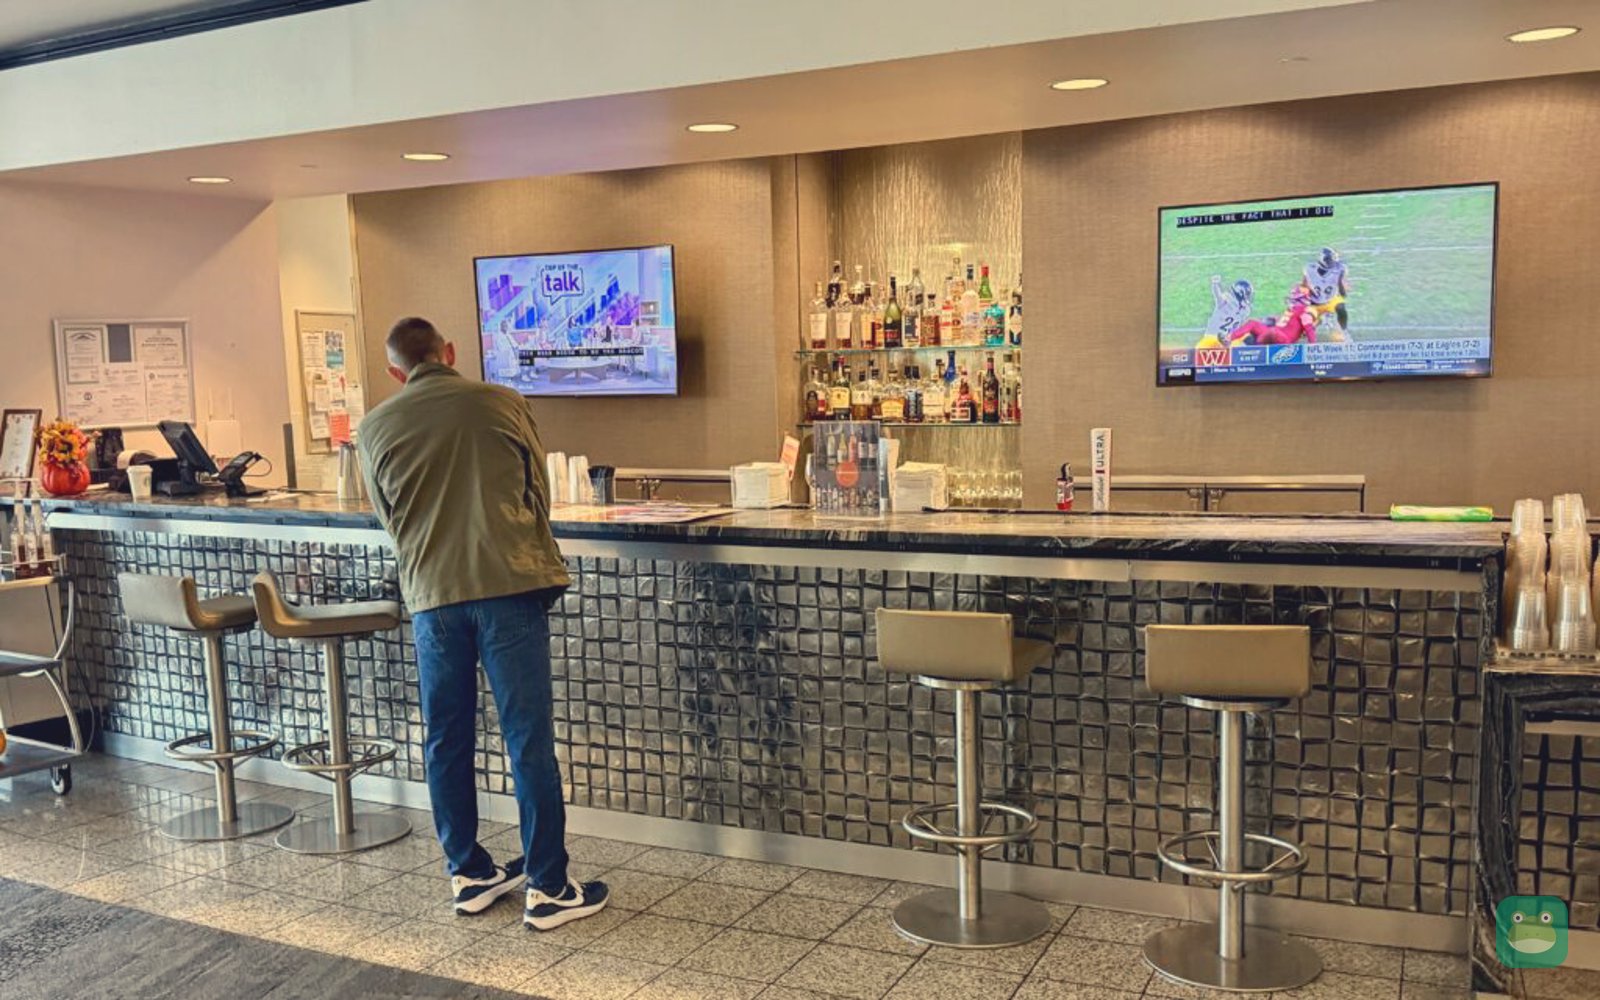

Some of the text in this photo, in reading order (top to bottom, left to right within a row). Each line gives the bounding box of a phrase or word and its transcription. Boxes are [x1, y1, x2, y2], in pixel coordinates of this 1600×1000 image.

[1178, 216, 1214, 226] DESPITE
[1221, 214, 1236, 222] THE
[1242, 211, 1264, 220] FACT
[1270, 209, 1292, 218] THAT
[1299, 208, 1309, 216] IT
[545, 271, 581, 292] talk
[1308, 345, 1322, 354] NFL
[1357, 342, 1405, 351] Commanders
[1426, 341, 1434, 349] at
[1435, 341, 1461, 350] Eagles
[1096, 434, 1105, 468] ULTRA
